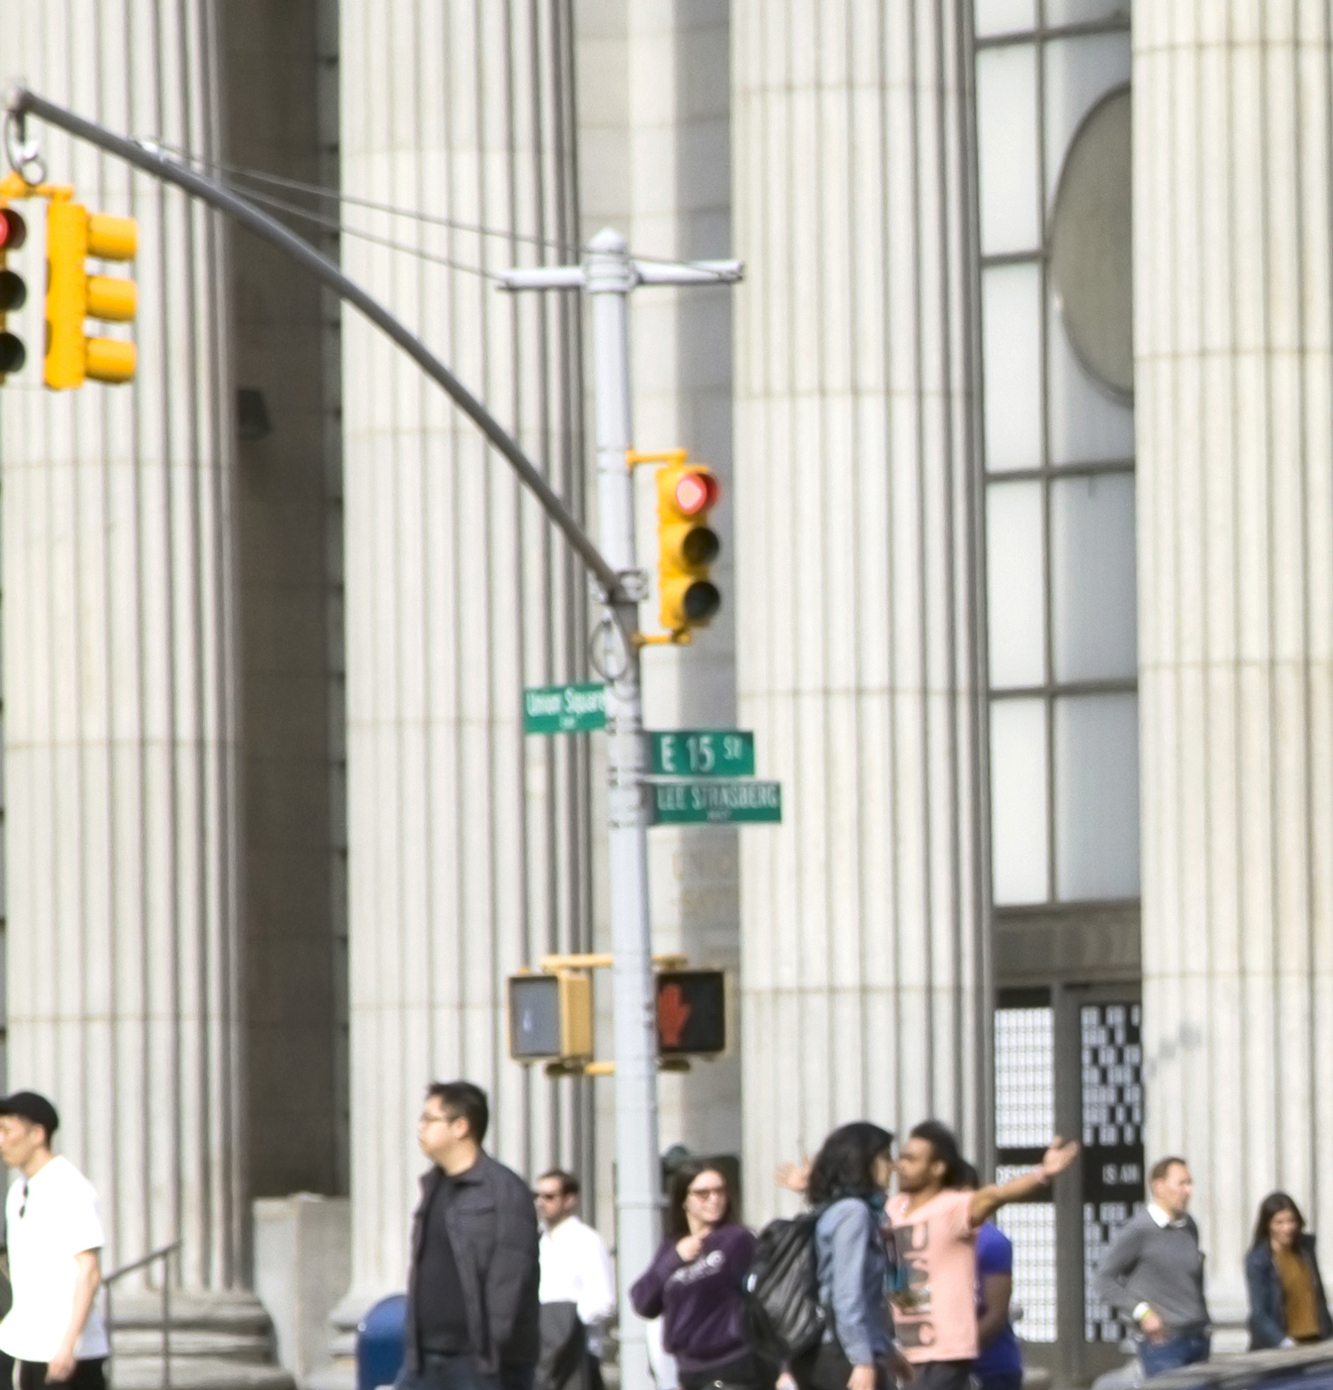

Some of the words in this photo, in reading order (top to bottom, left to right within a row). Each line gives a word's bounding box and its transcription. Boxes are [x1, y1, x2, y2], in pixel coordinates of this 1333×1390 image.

[661, 734, 676, 772] E
[685, 734, 716, 773] 15
[656, 785, 687, 811] LEE
[691, 784, 778, 809] STRASBERG
